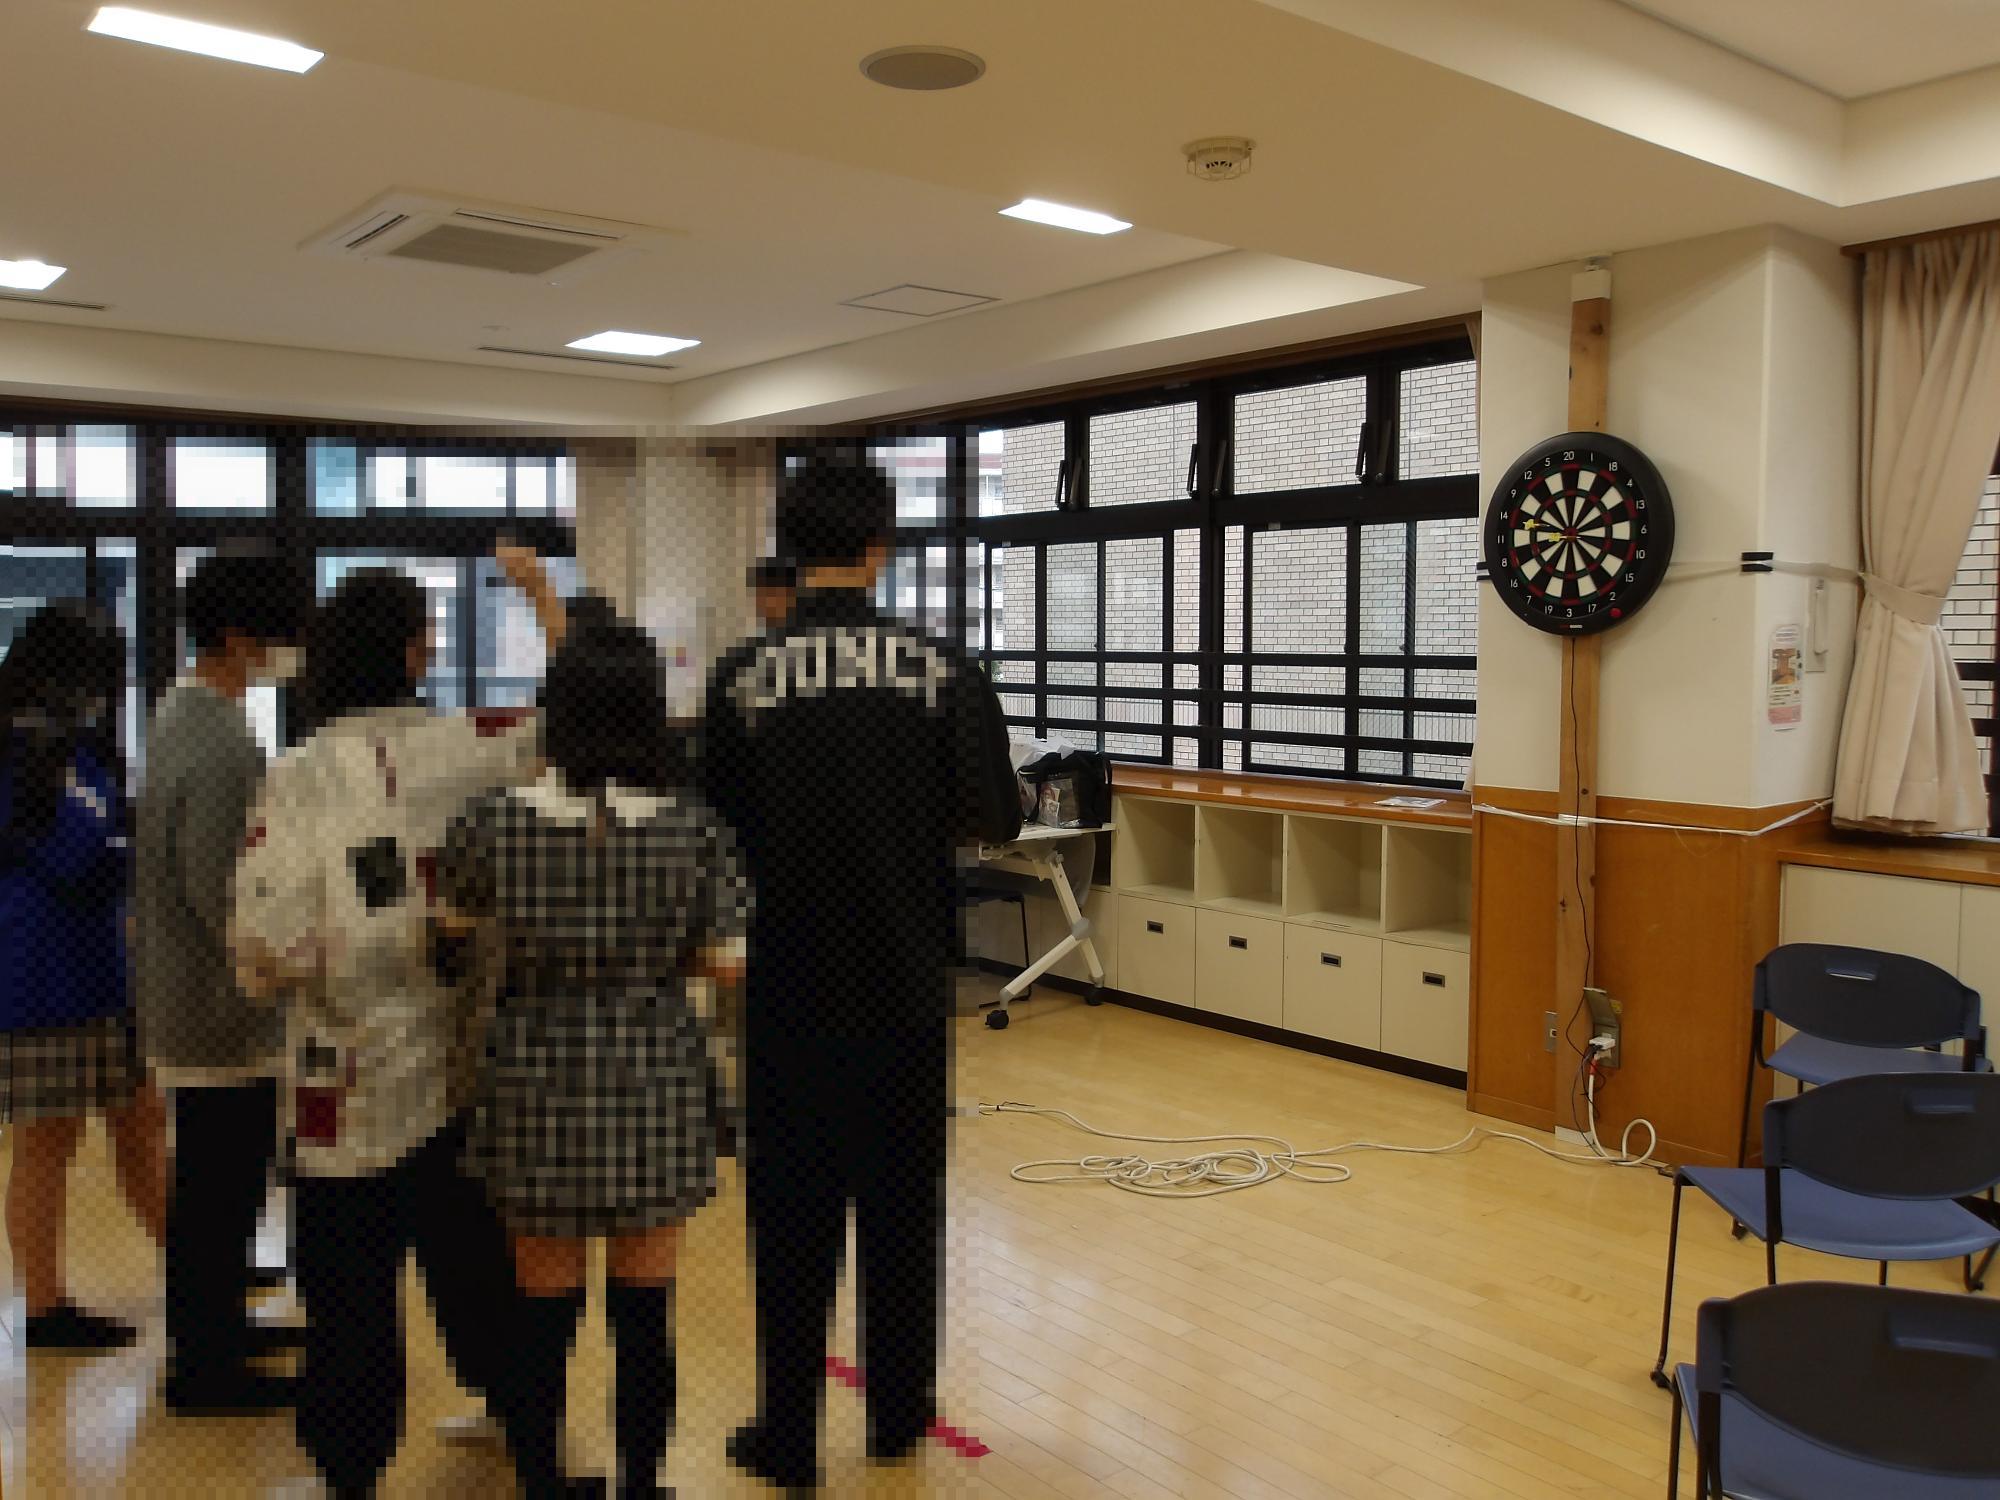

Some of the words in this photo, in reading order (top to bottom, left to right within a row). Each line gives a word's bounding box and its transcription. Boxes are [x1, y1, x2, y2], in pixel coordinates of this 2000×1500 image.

[1563, 451, 1575, 461] 20
[1544, 457, 1551, 467] 5
[1609, 462, 1618, 472] 18
[1524, 470, 1533, 481] 12
[1626, 478, 1633, 489] 4
[1511, 489, 1517, 499] 9
[1636, 500, 1645, 510] 13
[1501, 511, 1508, 520] 14
[1640, 524, 1648, 535] 6
[1497, 535, 1505, 544] 11
[1636, 549, 1645, 559] 10
[1501, 557, 1508, 567] 8
[1511, 578, 1518, 588] 16
[1626, 573, 1634, 583] 15
[1526, 595, 1532, 605] 7
[1609, 591, 1616, 601] 2
[1544, 605, 1554, 615] 19
[1566, 608, 1573, 618] 3
[1588, 603, 1597, 613] 17
